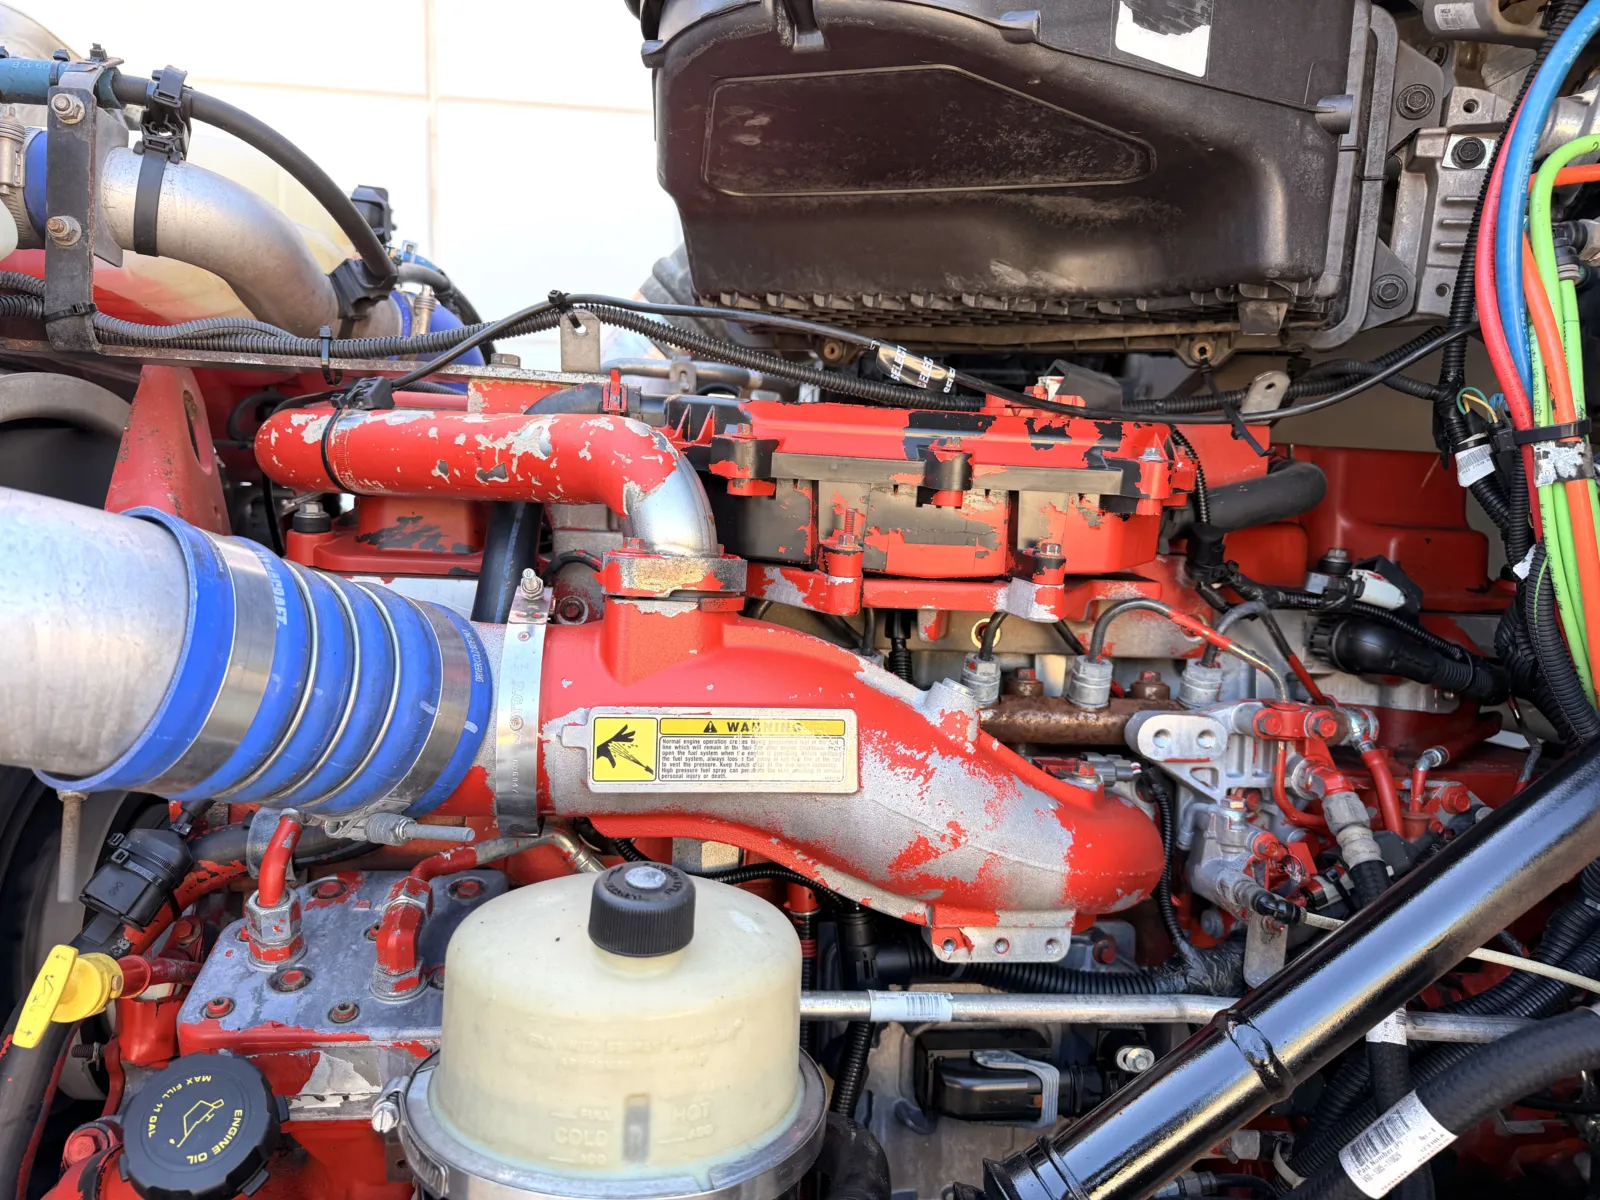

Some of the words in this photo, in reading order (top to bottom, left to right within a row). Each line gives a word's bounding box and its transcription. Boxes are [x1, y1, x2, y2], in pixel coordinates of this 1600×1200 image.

[890, 345, 907, 382] SELECT
[186, 1076, 212, 1085] MAX
[162, 1083, 182, 1099] FILL
[154, 1102, 163, 1112] 11
[580, 1107, 612, 1122] FULL
[672, 1102, 711, 1122] HOT
[148, 1116, 158, 1138] GAL
[211, 1109, 243, 1155] ENGINE
[554, 1127, 609, 1147] COLD
[186, 1151, 208, 1164] OIL
[1356, 1163, 1370, 1176] Part
[1369, 1146, 1393, 1166] Number
